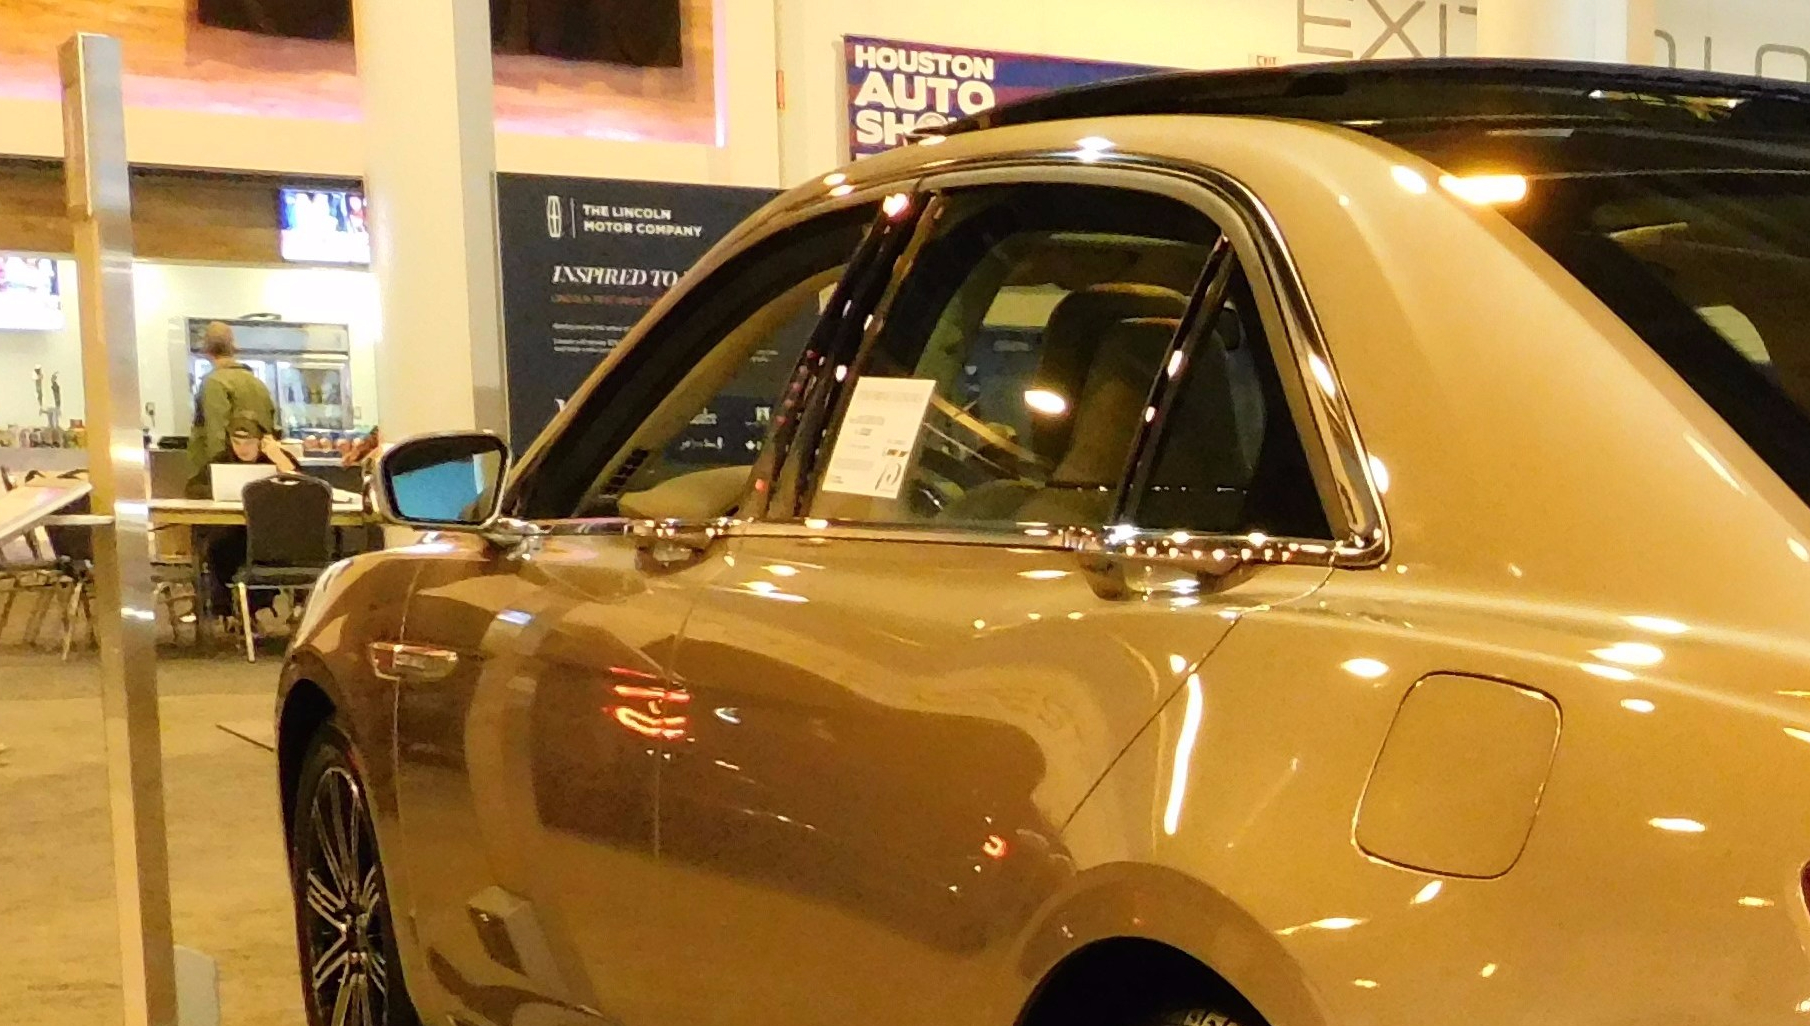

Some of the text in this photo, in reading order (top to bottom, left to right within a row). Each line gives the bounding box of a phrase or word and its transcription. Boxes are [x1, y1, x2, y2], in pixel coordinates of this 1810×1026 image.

[1297, 0, 1478, 60] EXI
[853, 44, 995, 81] HOUSTON
[854, 70, 996, 116] AUTO
[855, 108, 958, 146] SH
[582, 203, 672, 221] THE LINCOLN
[583, 220, 703, 238] MOTOR COMPANY
[551, 264, 679, 288] INSPIRED TO
